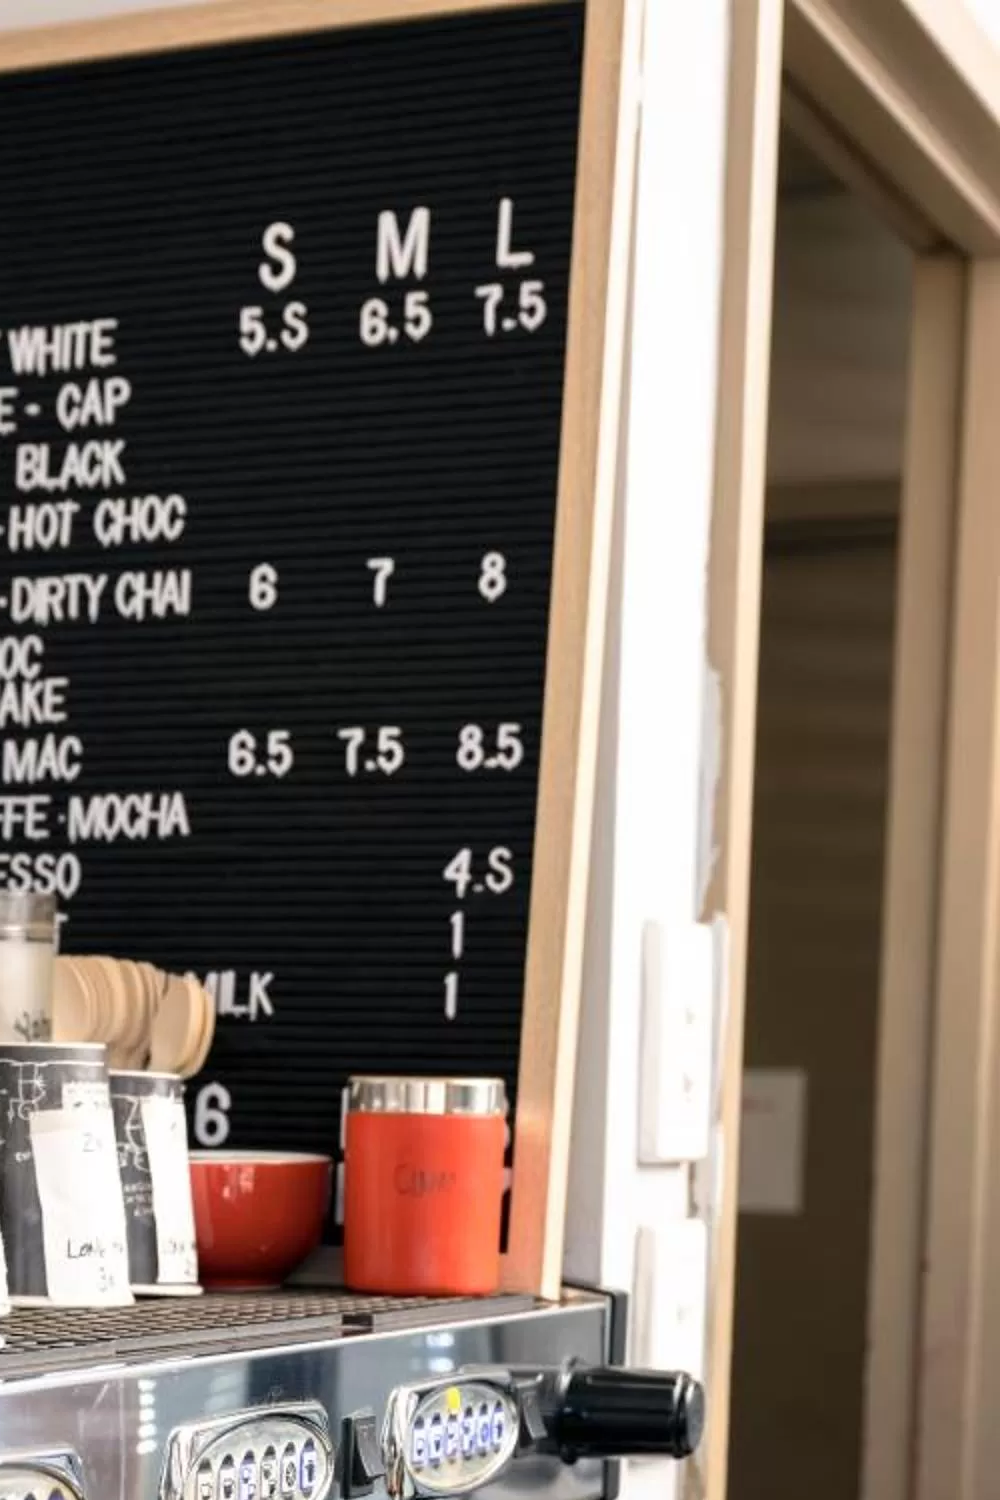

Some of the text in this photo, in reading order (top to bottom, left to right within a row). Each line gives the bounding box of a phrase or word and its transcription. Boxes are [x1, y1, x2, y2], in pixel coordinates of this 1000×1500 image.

[259, 198, 534, 291] S M L
[360, 291, 431, 345] 6.5
[475, 281, 546, 335] 7.5
[8, 319, 118, 378] WHITE
[57, 377, 130, 430] CAP
[16, 440, 125, 491] BLACK
[94, 494, 186, 546] CHOC
[115, 570, 191, 620] CHAI
[250, 563, 277, 609] 6
[367, 558, 394, 606] 7
[479, 552, 506, 601] 8
[3, 734, 82, 783] MAC
[229, 730, 292, 776] 6.5
[339, 727, 403, 775] 7.5
[457, 724, 523, 770] 8.5
